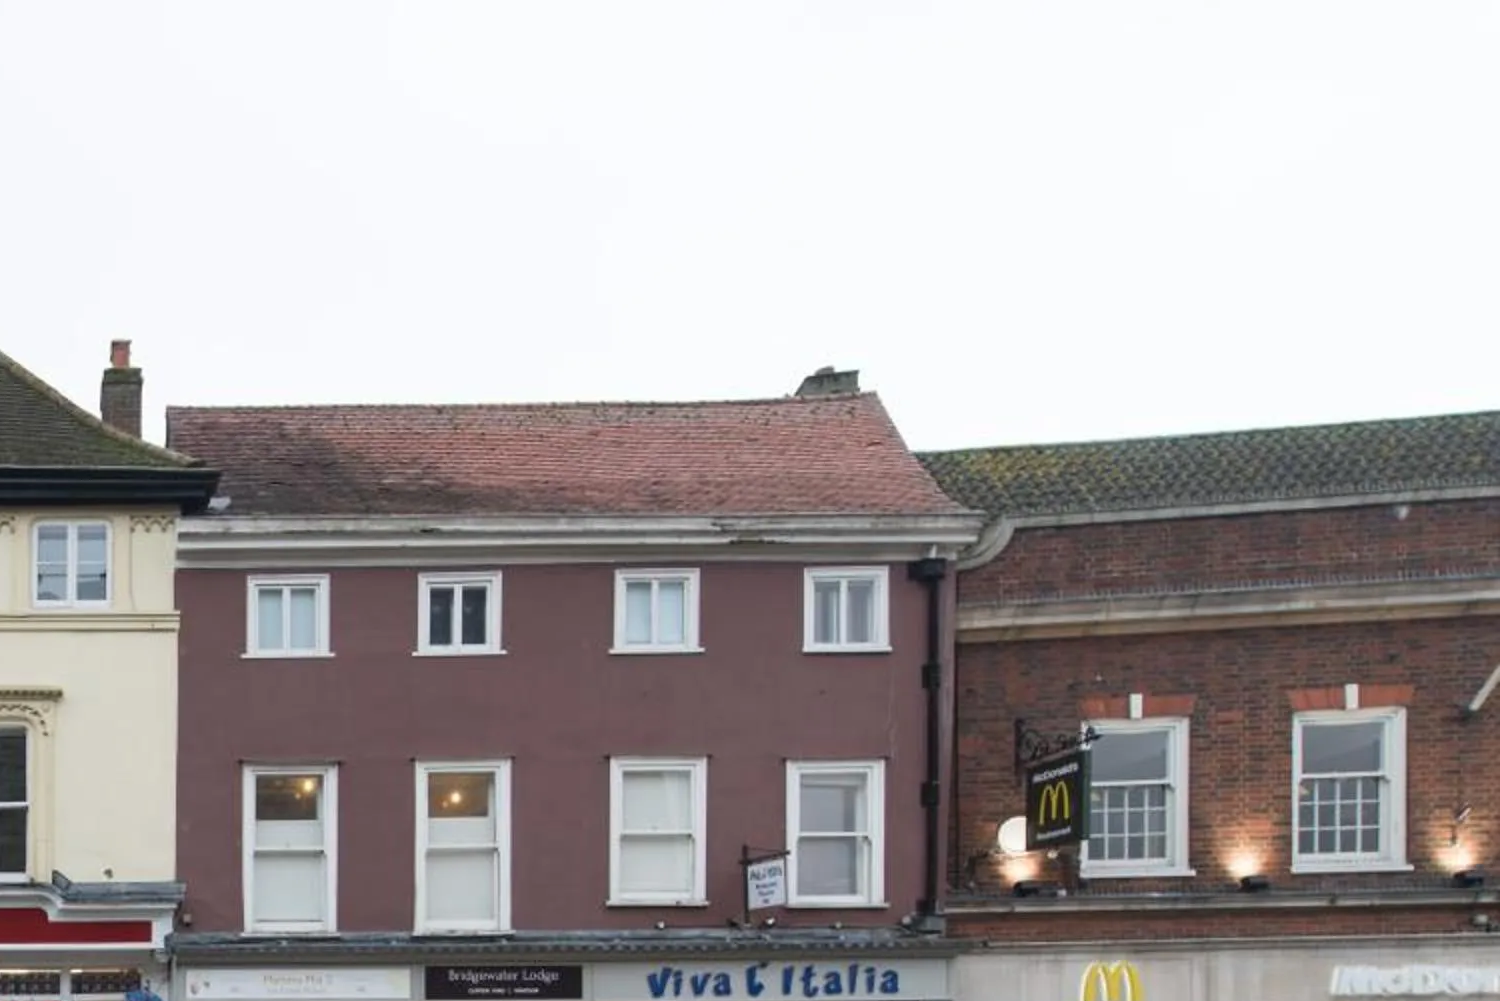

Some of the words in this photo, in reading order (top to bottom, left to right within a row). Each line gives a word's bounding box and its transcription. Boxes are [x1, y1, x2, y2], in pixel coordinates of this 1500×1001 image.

[448, 968, 519, 984] Bridgewater
[522, 967, 560, 984] Lodge
[646, 967, 732, 998] Viva
